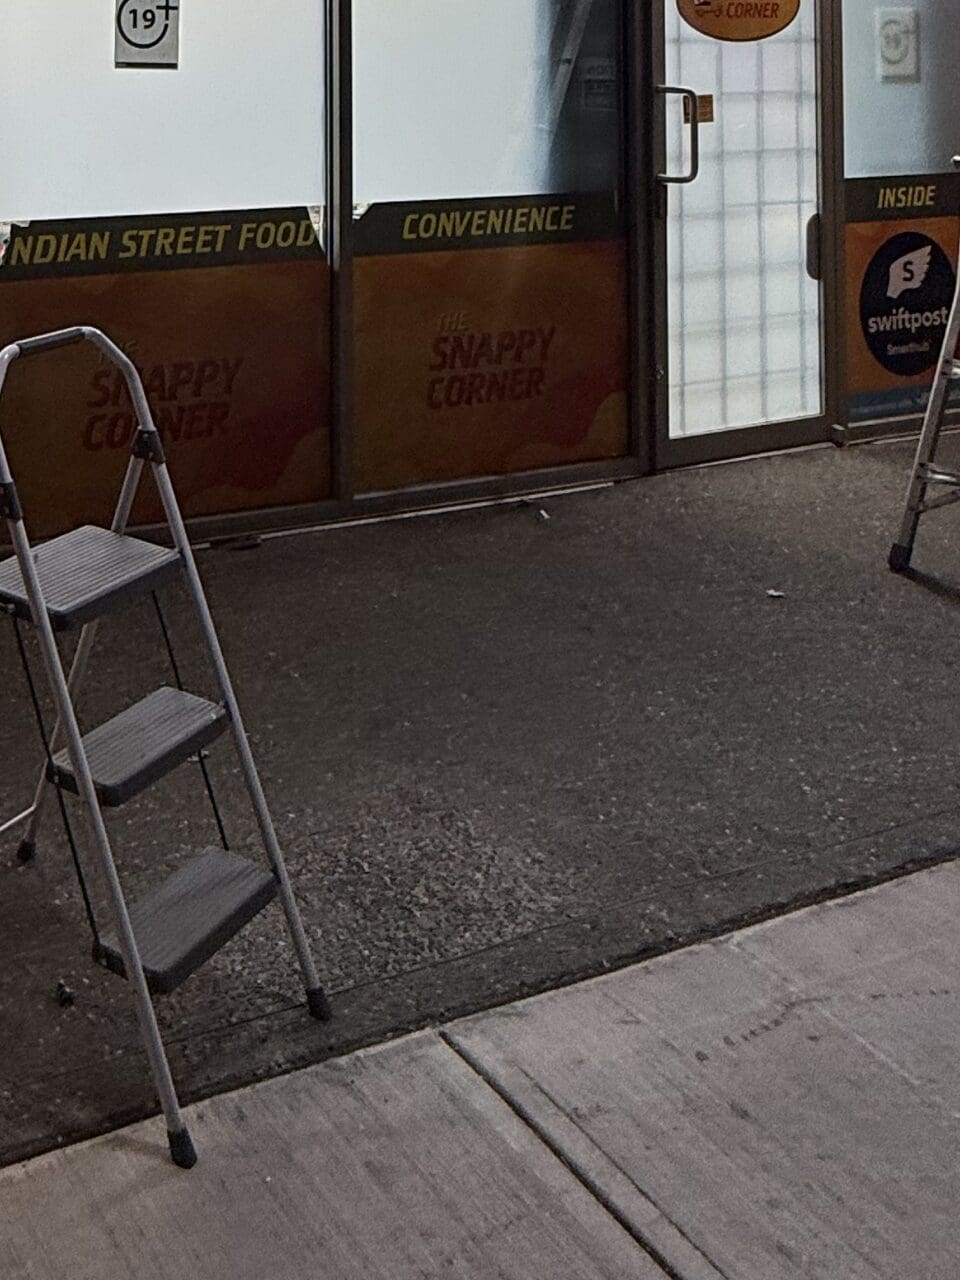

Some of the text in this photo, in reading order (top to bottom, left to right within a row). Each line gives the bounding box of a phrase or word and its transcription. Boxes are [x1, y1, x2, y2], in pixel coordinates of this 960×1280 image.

[726, 2, 780, 19] CORNER
[877, 185, 937, 209] INSIDE
[402, 205, 576, 240] CONVENIENCE
[10, 220, 317, 266] NDIAN STREET FOOD
[868, 306, 949, 333] swiftpost
[429, 325, 556, 371] SNAPPY
[426, 366, 547, 410] CORNER
[82, 402, 232, 451] CONER
